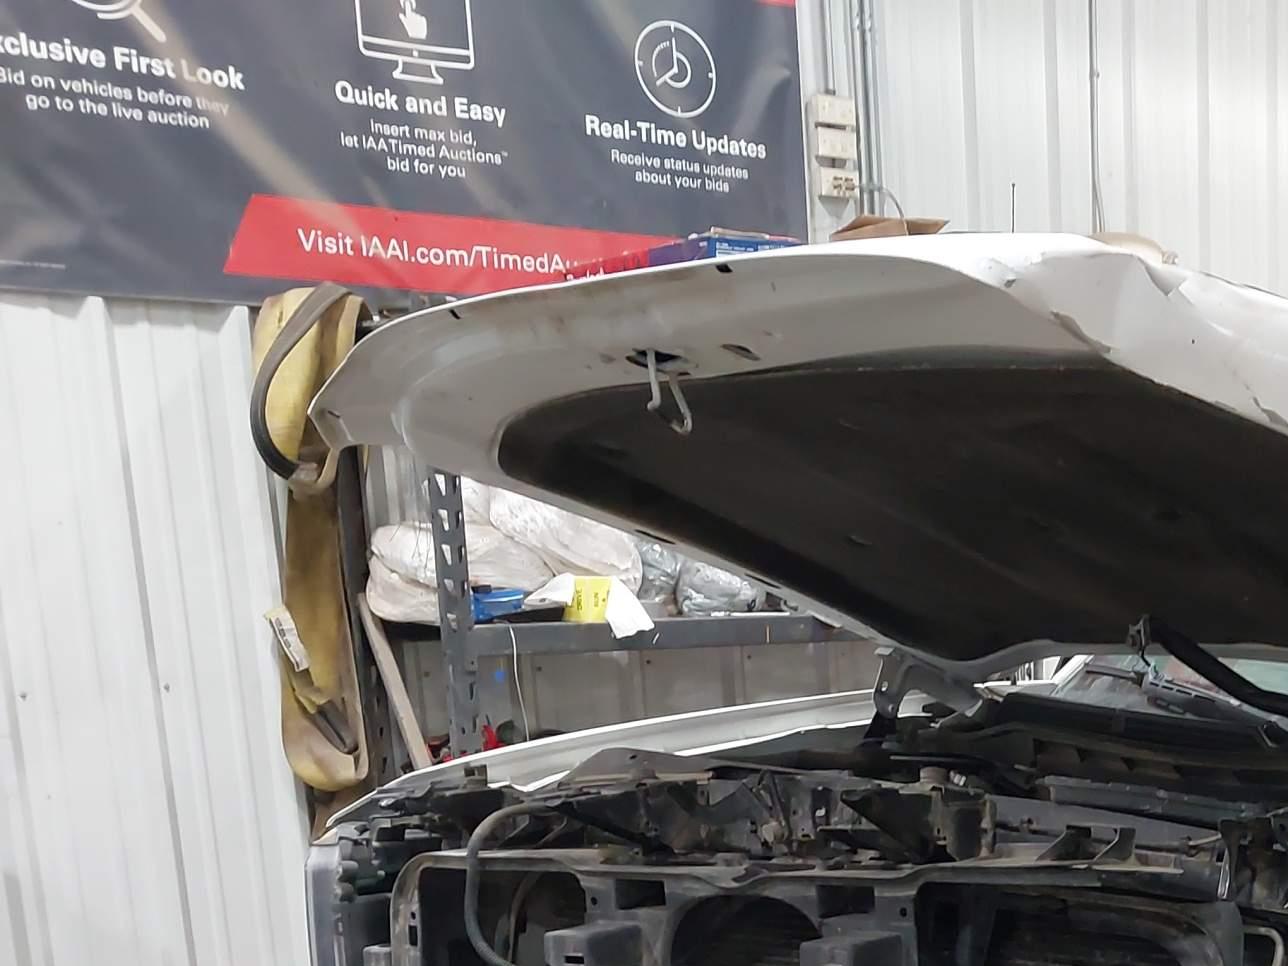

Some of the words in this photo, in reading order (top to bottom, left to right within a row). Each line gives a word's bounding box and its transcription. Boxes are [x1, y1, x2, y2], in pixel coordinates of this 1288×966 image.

[113, 46, 176, 79] First
[180, 58, 246, 91] Look
[25, 94, 51, 111] go
[54, 95, 75, 112] to
[78, 98, 108, 117] the
[111, 101, 143, 121] live
[147, 110, 210, 129] auction
[31, 74, 55, 90] on
[60, 78, 133, 102] vehicles
[136, 85, 193, 109] before
[194, 95, 230, 117] they
[334, 79, 399, 111] Quick
[405, 95, 448, 117] and
[454, 96, 506, 128] Easy
[340, 131, 360, 149] let
[369, 118, 411, 139] Insert
[414, 127, 446, 143] max
[449, 128, 477, 148] bid,
[584, 114, 688, 148] Real-Time
[691, 129, 768, 160] Updates
[386, 155, 410, 173] bid
[413, 158, 435, 175] for
[438, 163, 466, 180] you
[610, 148, 661, 169] Receive
[664, 156, 701, 174] status
[703, 164, 749, 180] updates
[634, 169, 672, 187] about
[674, 175, 702, 190] your
[705, 176, 730, 194] bids
[297, 227, 355, 257] Visit
